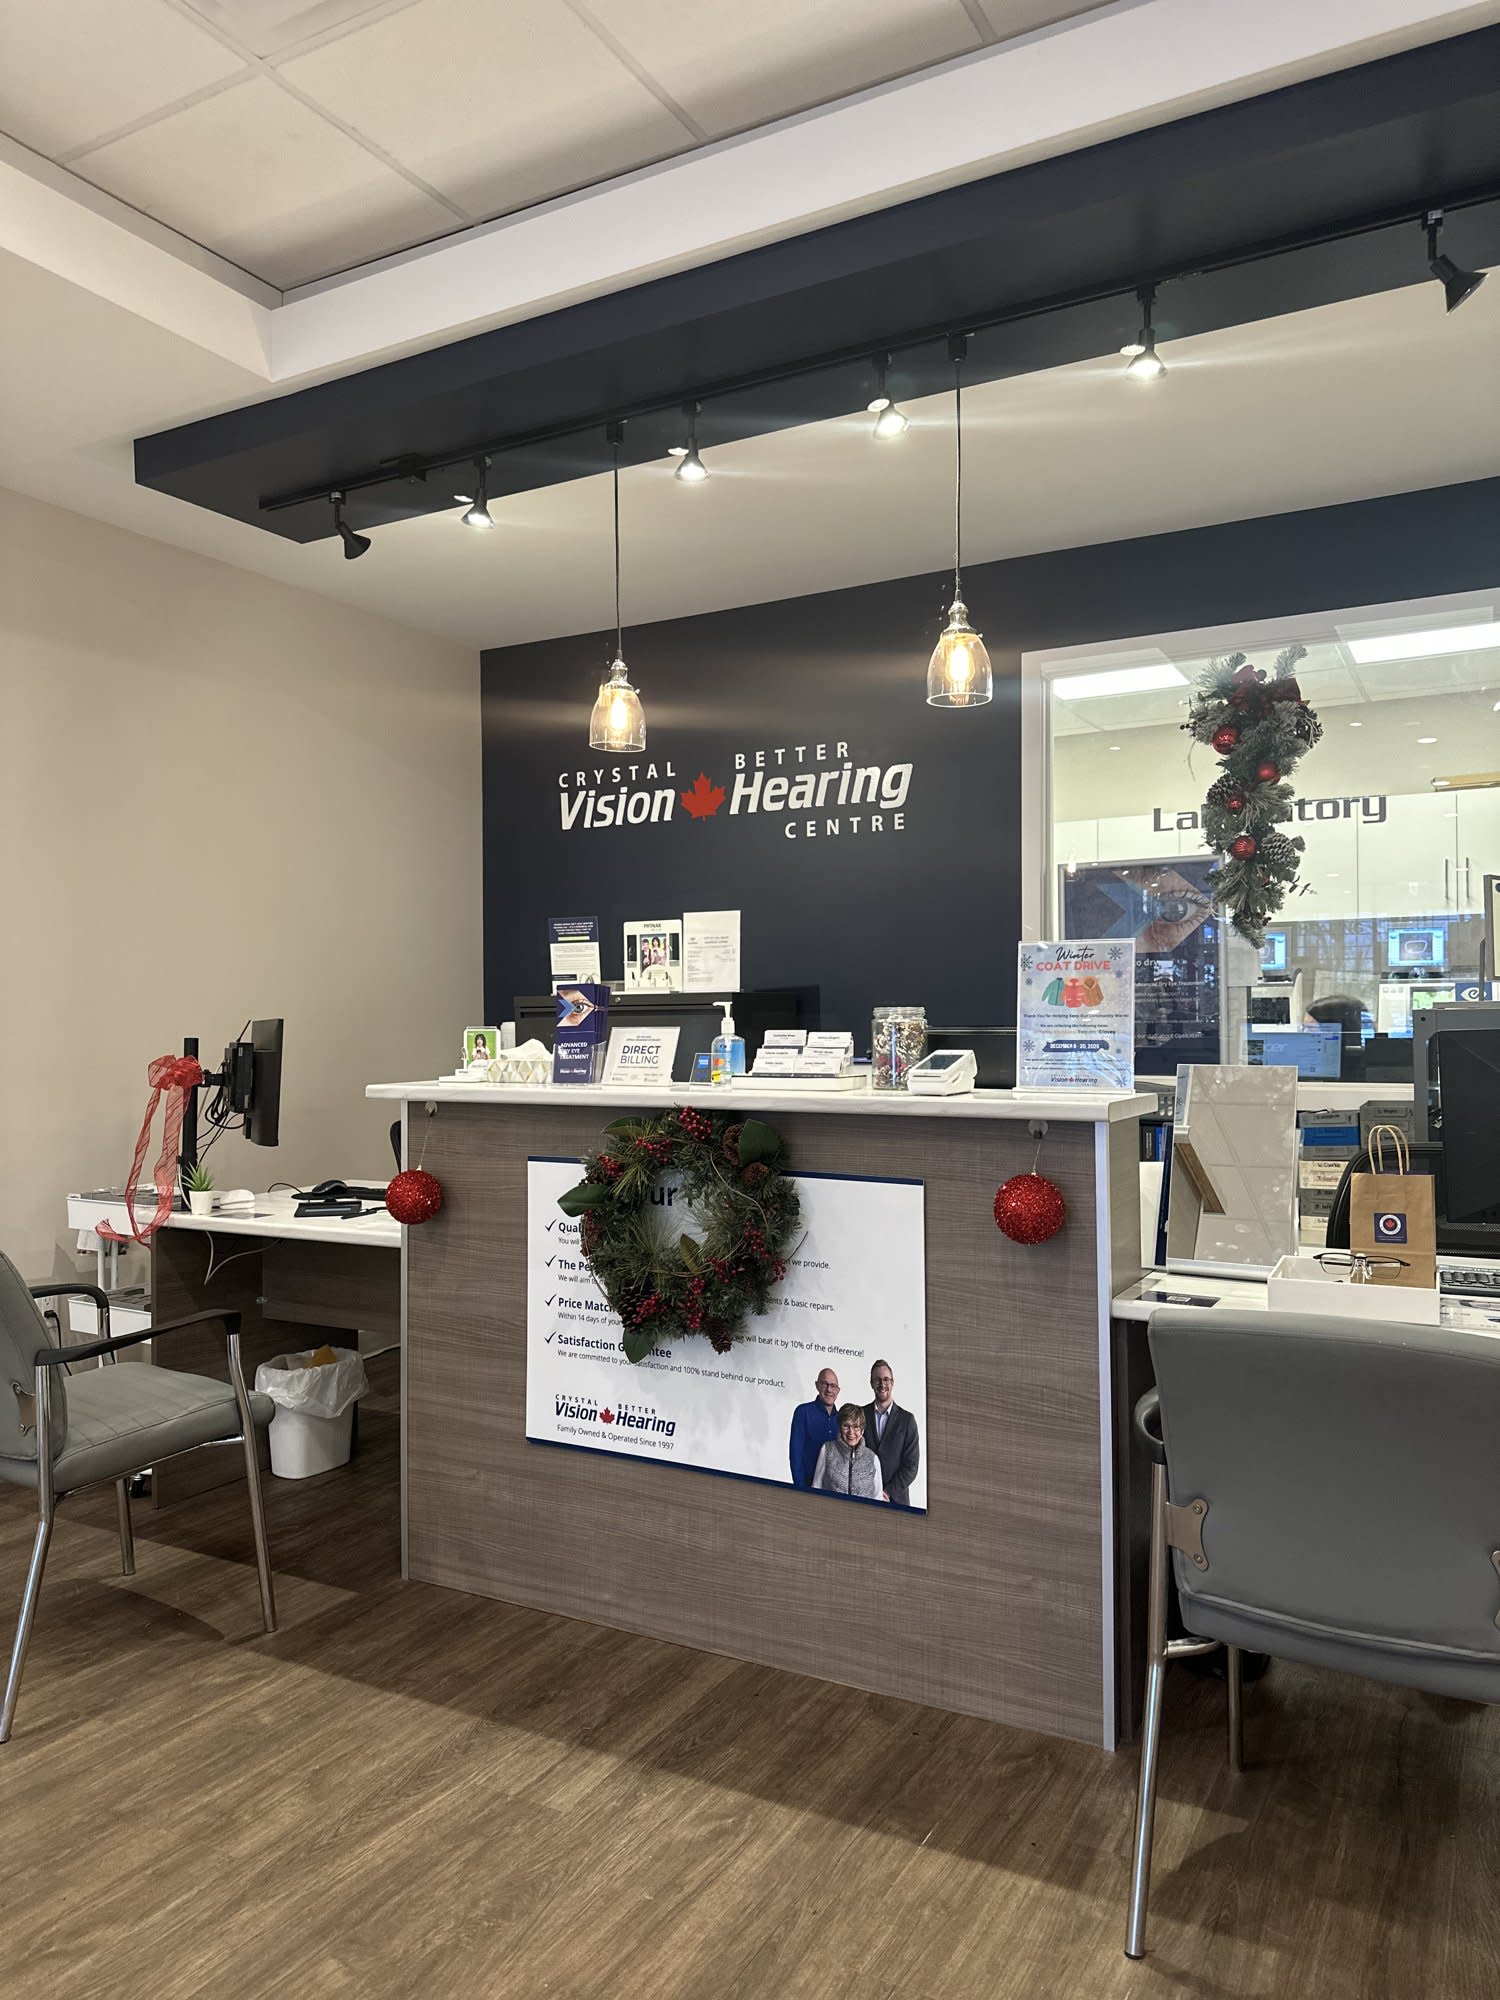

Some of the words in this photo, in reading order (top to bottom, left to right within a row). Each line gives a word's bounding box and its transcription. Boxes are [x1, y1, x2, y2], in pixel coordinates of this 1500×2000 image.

[735, 741, 849, 770] BETTER
[558, 761, 676, 789] CRYSTAL
[559, 786, 675, 831] Vision
[729, 762, 913, 816] Hearing
[1153, 795, 1387, 832] Latory
[784, 813, 905, 839] CENTRE
[1055, 945, 1095, 962] Winter
[1036, 961, 1072, 971] COAT
[1073, 960, 1111, 971] DRIVE
[622, 1045, 661, 1055] DIRECT
[620, 1055, 659, 1065] BILLING
[558, 1221, 582, 1234] Qual
[558, 1259, 577, 1271] The
[792, 1259, 802, 1267] we
[558, 1274, 568, 1282] We
[558, 1297, 583, 1309] Price
[791, 1299, 809, 1309] basic
[558, 1311, 577, 1321] Within
[578, 1314, 585, 1322] 14
[586, 1314, 600, 1324] days
[601, 1316, 608, 1324] of
[558, 1334, 616, 1352] Satisfaction
[618, 1342, 672, 1359] Gntee
[746, 1335, 757, 1343] will
[758, 1336, 773, 1345] beat
[780, 1339, 789, 1350] by
[791, 1340, 805, 1350] 10%
[805, 1342, 813, 1351] of
[814, 1343, 826, 1353] the
[558, 1349, 566, 1357] We
[567, 1351, 578, 1359] are
[579, 1353, 611, 1364] committed
[611, 1356, 619, 1365] to
[669, 1364, 682, 1373] and
[683, 1366, 700, 1376] 100%
[701, 1368, 720, 1378] stand
[720, 1371, 744, 1382] behind
[744, 1375, 756, 1384] our
[757, 1377, 786, 1388] product.
[555, 1394, 599, 1407] CRYSTAL
[618, 1403, 656, 1415] BETTER
[555, 1401, 598, 1422] Vision
[615, 1411, 676, 1437] Hearing
[557, 1424, 577, 1436] Family
[577, 1427, 601, 1438] Owned
[601, 1431, 607, 1439] &
[607, 1432, 639, 1444] Operated
[639, 1438, 657, 1448] Since
[658, 1440, 674, 1450] 1997
